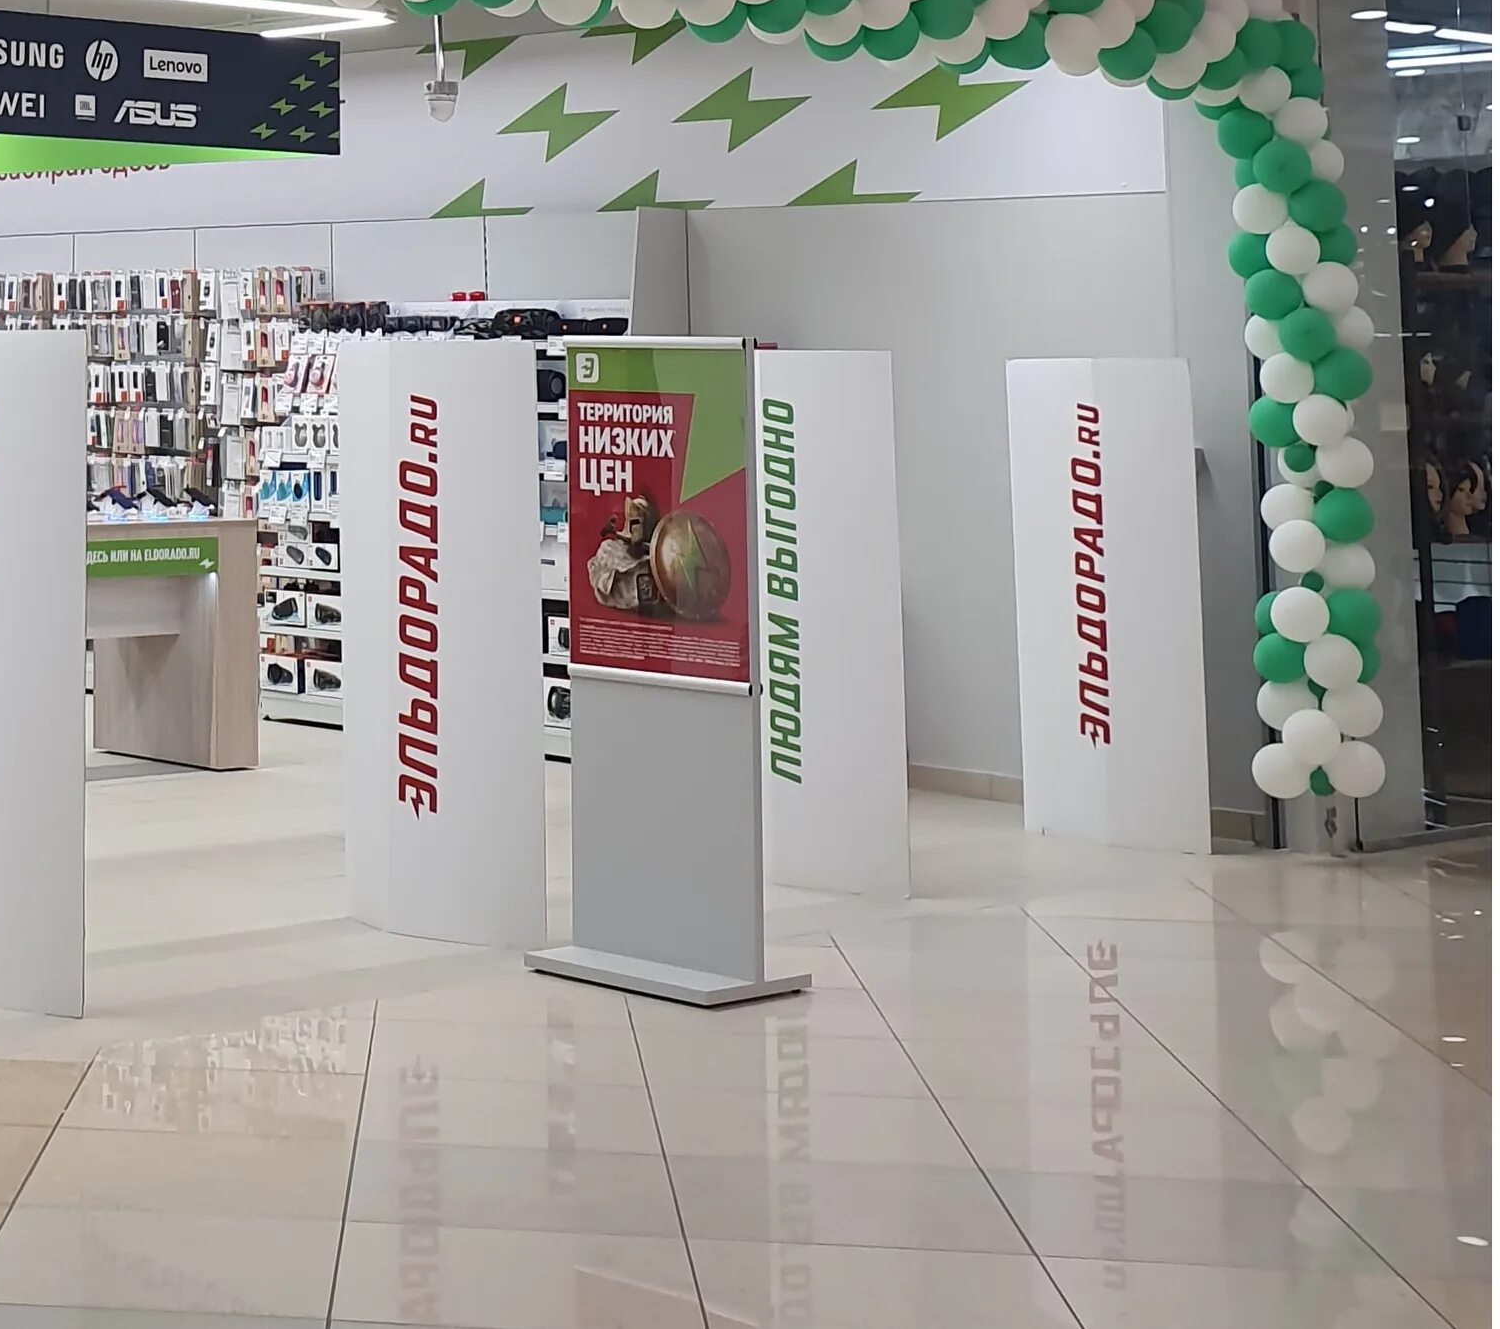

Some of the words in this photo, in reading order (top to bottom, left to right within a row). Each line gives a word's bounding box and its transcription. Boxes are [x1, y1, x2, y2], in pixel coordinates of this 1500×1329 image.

[87, 40, 117, 81] hp
[149, 55, 203, 75] Lenovo
[113, 99, 198, 129] ASUS
[577, 401, 674, 425] ТЕРРИТОРИЯ
[578, 425, 676, 459] НИЗКИХ
[578, 458, 634, 496] ЦЕН
[762, 397, 799, 602] ВЫГОДНО
[130, 548, 143, 562] НА
[144, 546, 200, 562] ELDORADO.RU
[1071, 402, 1112, 750] ЭЛЬДОРАДО.RU
[398, 394, 439, 821] ЭЛЬДОРАДО.RU
[767, 611, 803, 785] ЛЮДЯМ
